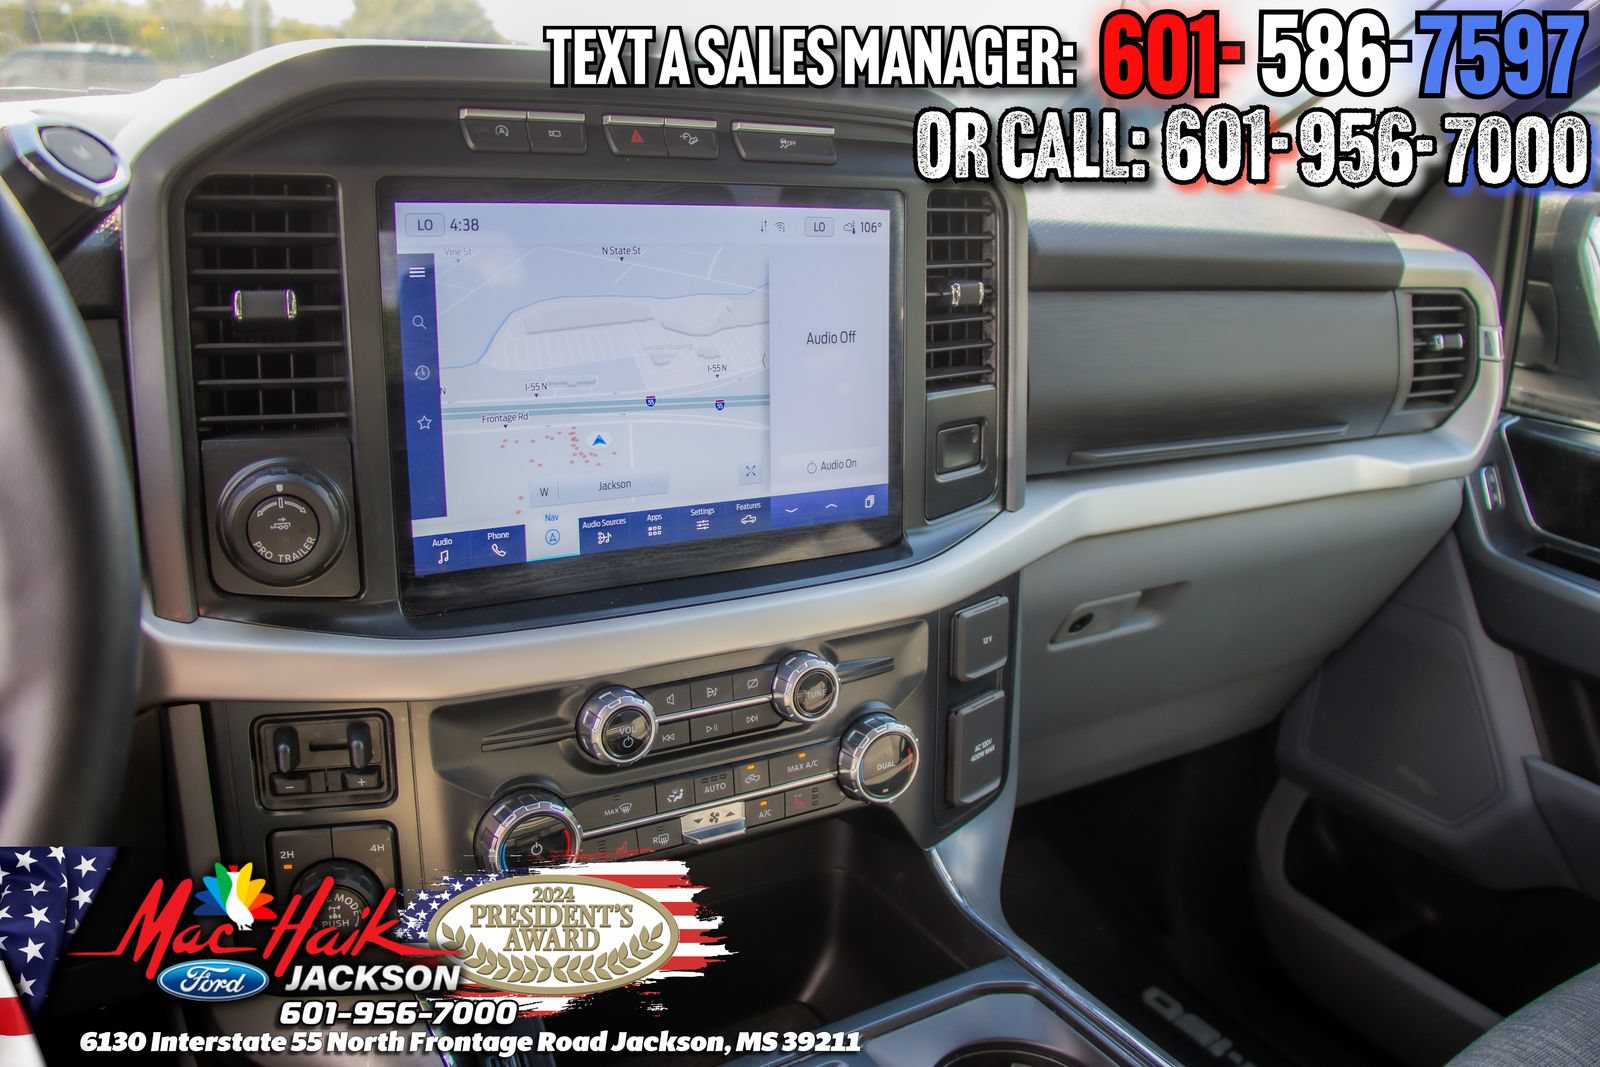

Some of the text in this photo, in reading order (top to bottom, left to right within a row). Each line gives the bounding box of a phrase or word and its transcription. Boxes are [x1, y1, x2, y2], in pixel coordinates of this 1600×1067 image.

[417, 218, 480, 232] LO 4:38
[813, 222, 826, 232] LO
[463, 247, 472, 256] St
[602, 247, 641, 256] N State St
[806, 330, 857, 345] Audio Off
[707, 363, 727, 373] I-55 N
[525, 382, 548, 391] I-55 N
[482, 412, 528, 423] Frontage Rd
[820, 459, 857, 471] Audio On
[598, 479, 632, 491] Jackson
[539, 488, 549, 497] W
[736, 502, 761, 511] Features
[690, 507, 715, 517] Settings
[544, 513, 560, 522] Nav
[646, 513, 663, 522] Apps
[582, 517, 627, 529] Audio Sources
[487, 531, 510, 540] Phone
[432, 538, 453, 547] Audio
[253, 536, 316, 563] PRO TRAILER
[806, 689, 827, 699] TUNE
[619, 725, 637, 735] VOL
[787, 758, 819, 773] MAX A/C
[876, 760, 896, 771] DUAL
[704, 783, 727, 794] AUTO
[604, 808, 619, 816] MAX
[758, 808, 772, 818] A/C
[370, 844, 385, 852] 4H
[280, 851, 294, 859] 2H
[334, 893, 361, 917] MODE
[322, 919, 350, 928] PUSH
